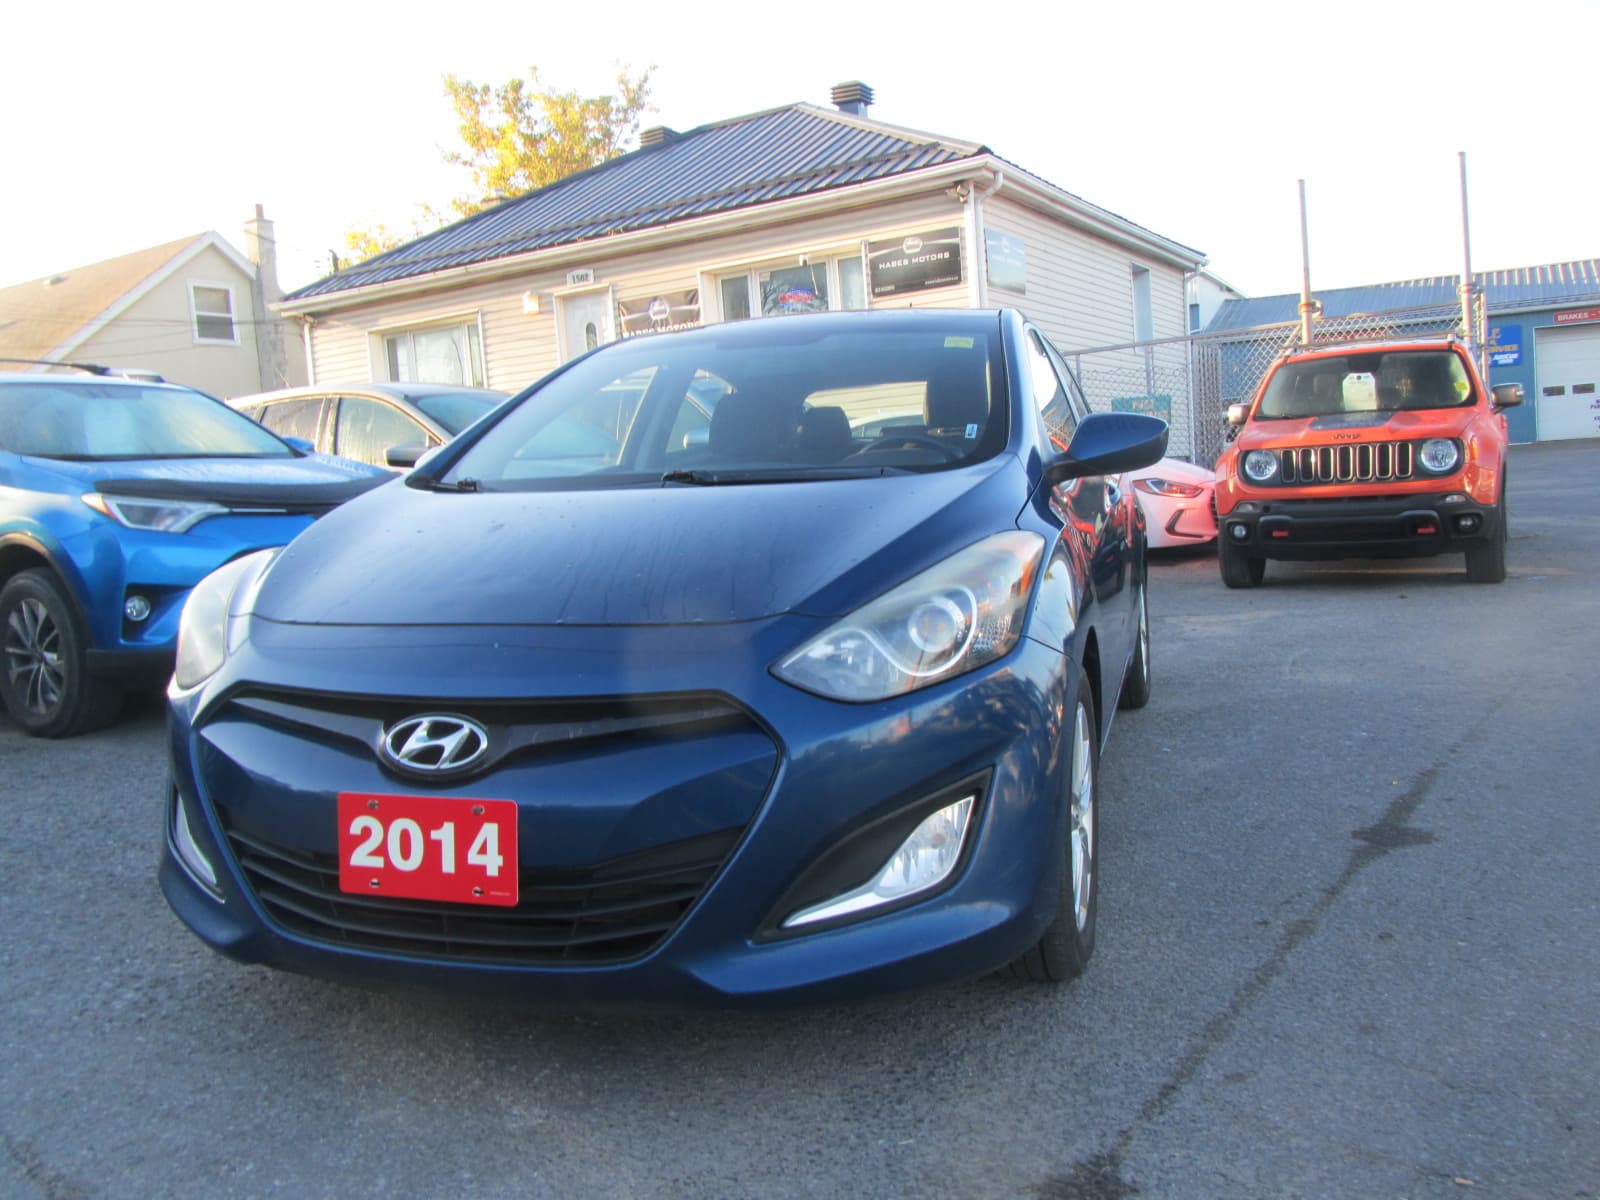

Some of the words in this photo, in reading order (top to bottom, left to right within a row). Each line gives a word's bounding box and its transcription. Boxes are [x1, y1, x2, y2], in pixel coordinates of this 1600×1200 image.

[912, 251, 950, 264] MOTORS
[1557, 312, 1590, 321] BRAKES
[350, 815, 504, 877] 2014
